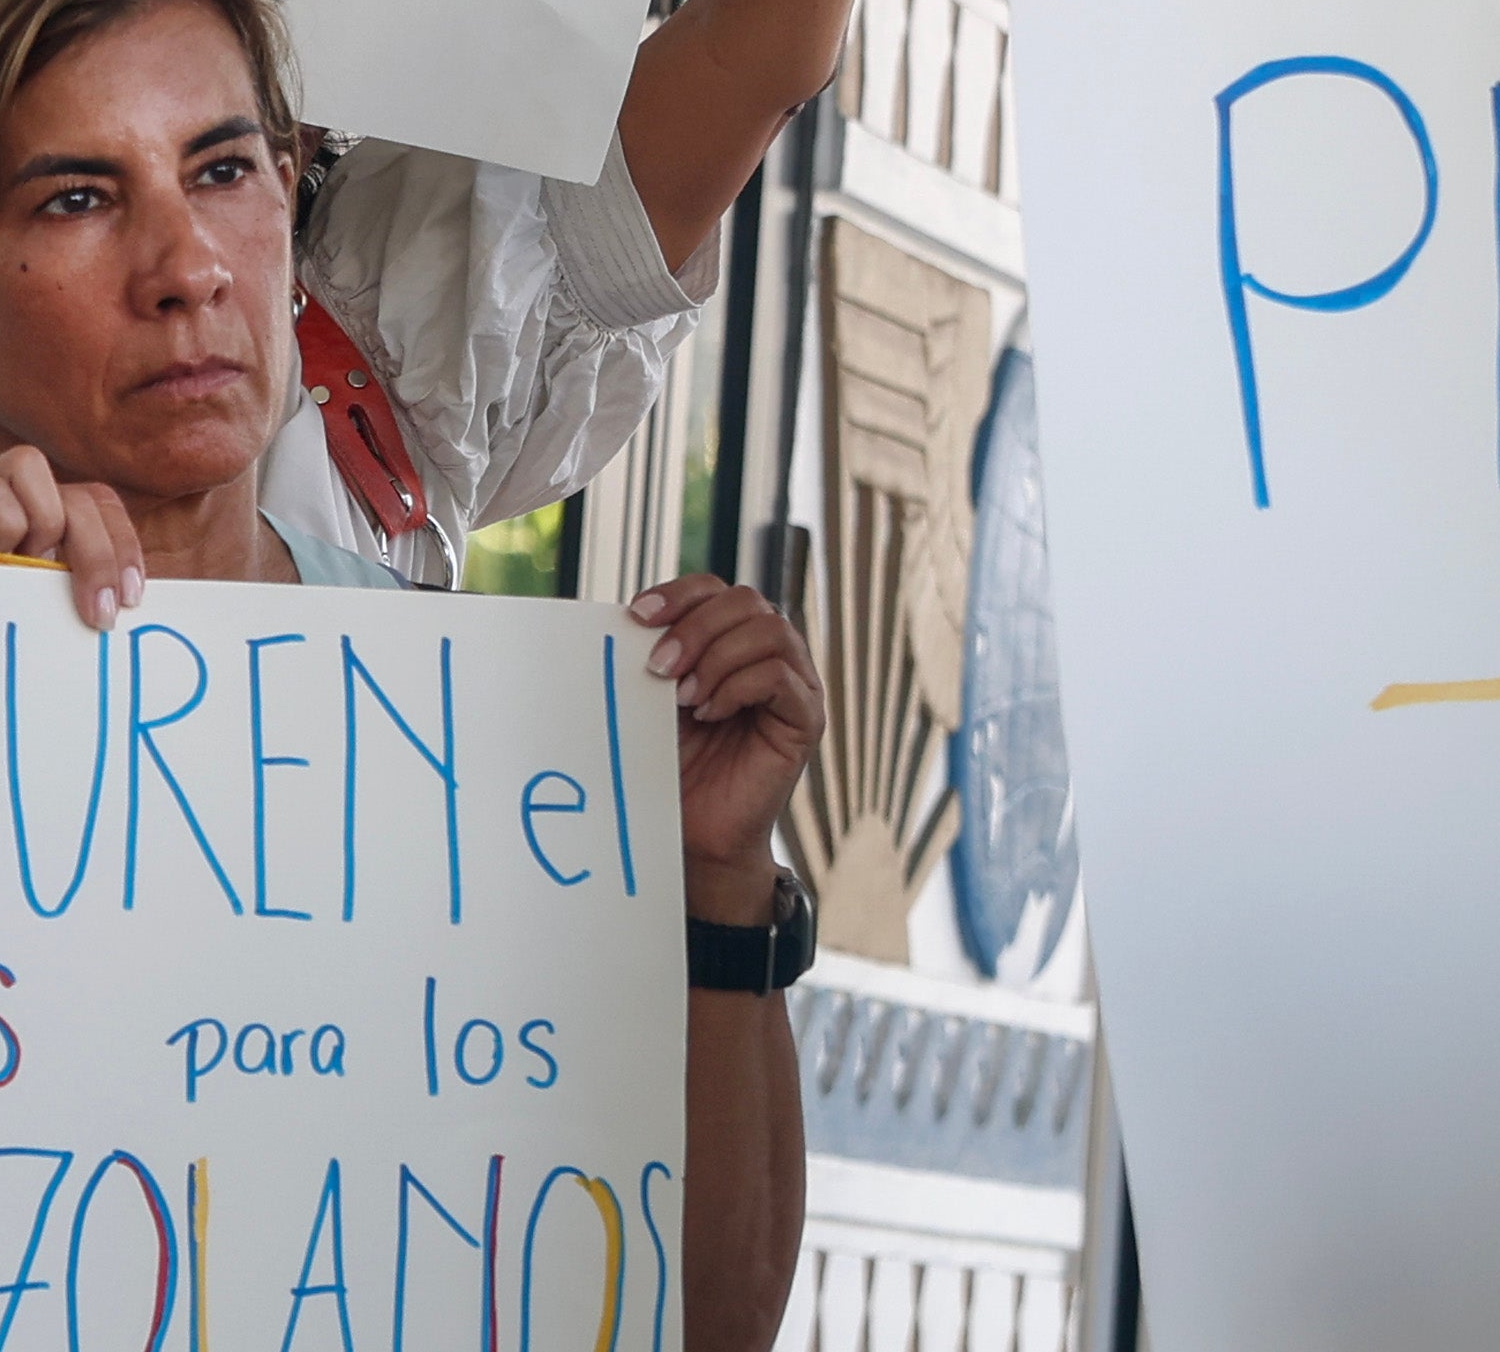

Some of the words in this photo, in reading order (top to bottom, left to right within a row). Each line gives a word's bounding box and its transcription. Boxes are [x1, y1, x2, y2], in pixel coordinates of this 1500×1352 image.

[520, 633, 637, 898] el
[166, 1016, 346, 1103] para
[423, 975, 558, 1097] los
